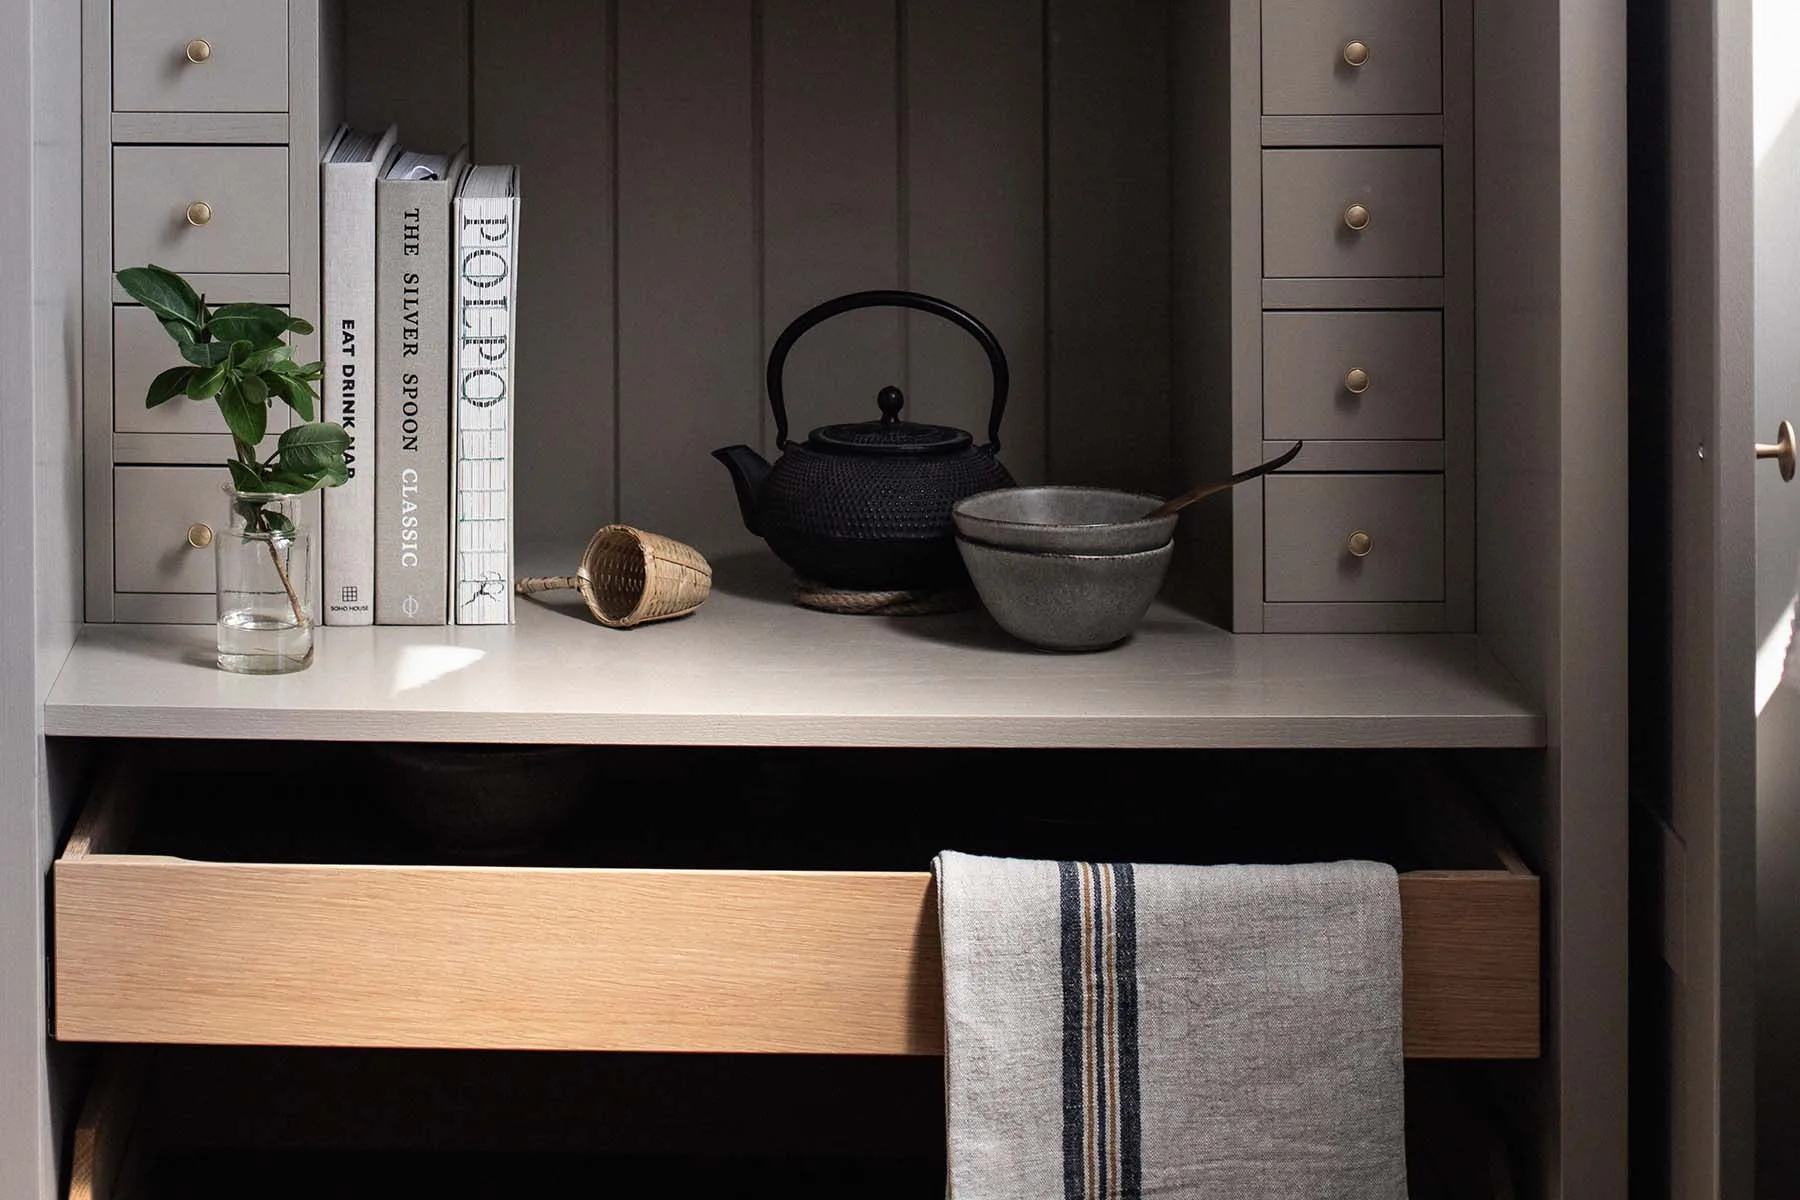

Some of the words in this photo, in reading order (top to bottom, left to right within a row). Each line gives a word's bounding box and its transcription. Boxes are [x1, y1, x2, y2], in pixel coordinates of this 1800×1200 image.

[403, 208, 420, 256] THE
[342, 319, 355, 357] EAT
[403, 273, 420, 357] SILVER
[462, 215, 509, 408] POLPO
[342, 364, 356, 429] DRINK
[402, 373, 418, 452] SPOON
[401, 468, 418, 567] CLASSIC
